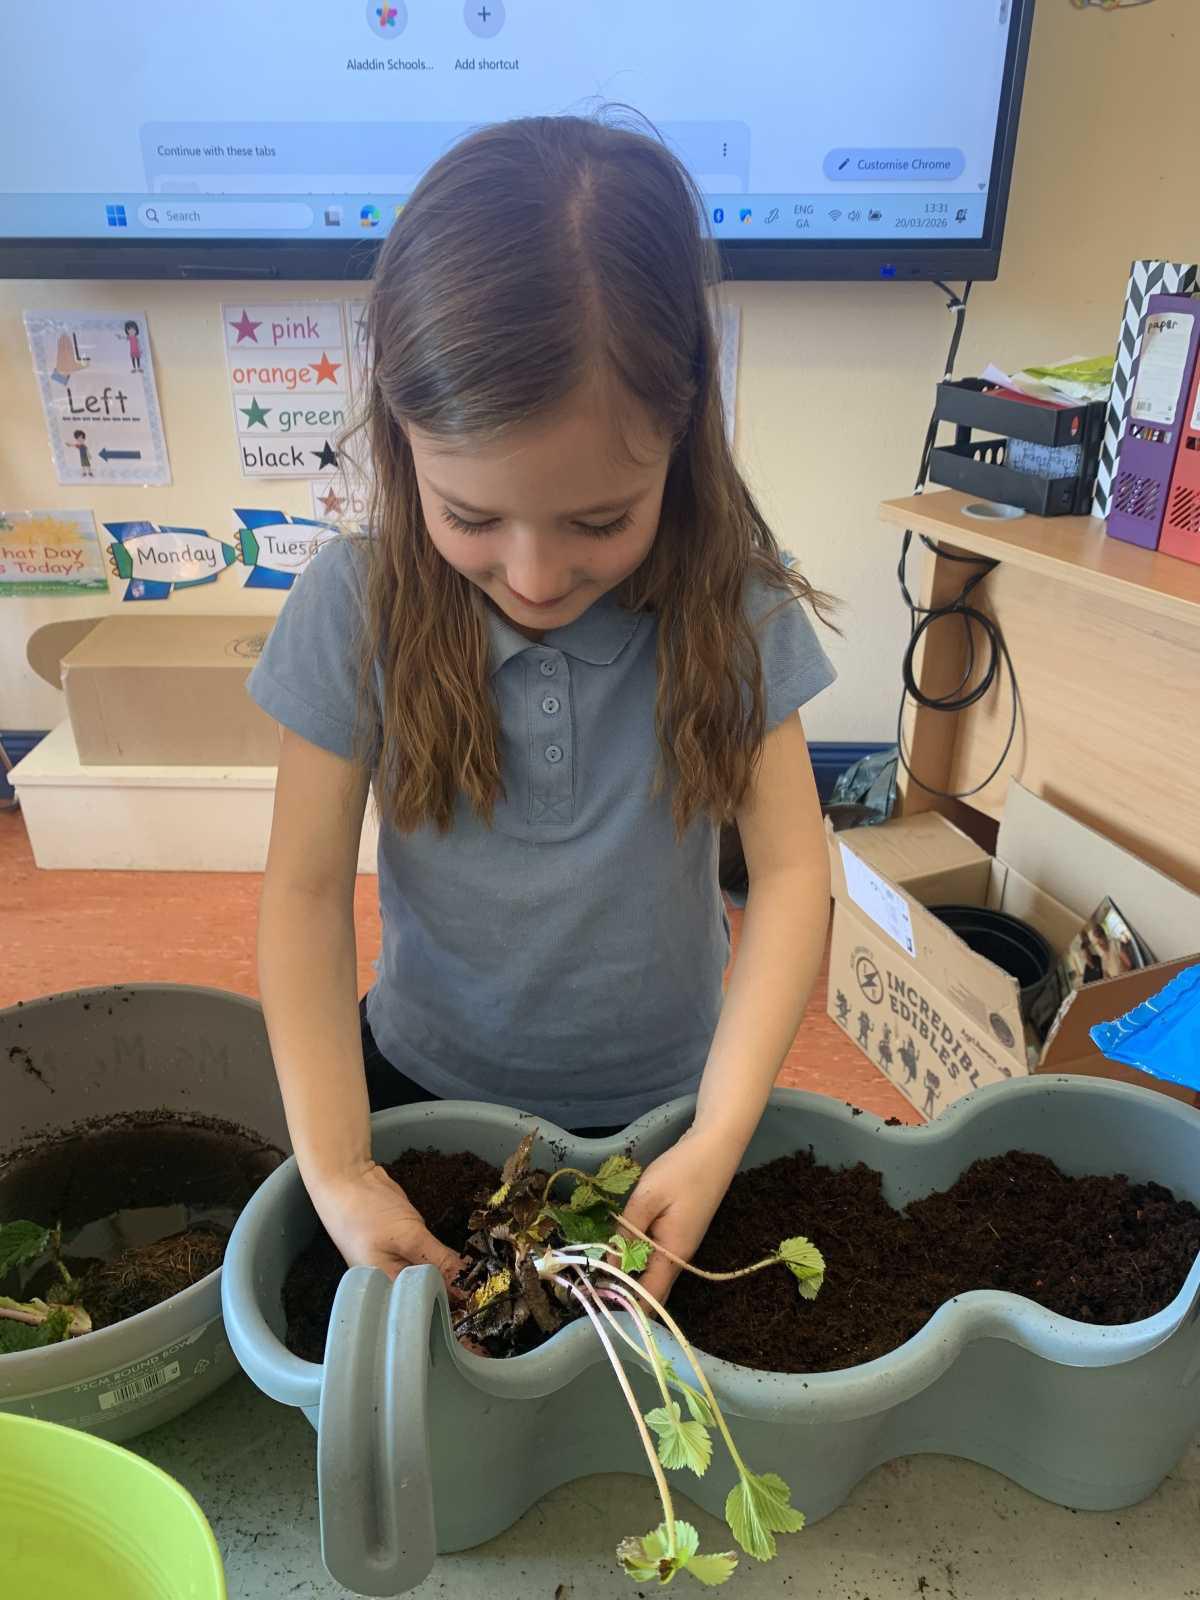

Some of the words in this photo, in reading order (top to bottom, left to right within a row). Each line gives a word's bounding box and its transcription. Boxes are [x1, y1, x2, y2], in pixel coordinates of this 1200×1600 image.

[347, 58, 385, 71] Aladdin
[454, 58, 476, 71] Add
[478, 58, 520, 71] shortcut
[157, 145, 201, 157] Continue
[203, 145, 225, 157] with
[226, 145, 253, 157] these
[255, 145, 276, 157] tabs
[857, 158, 909, 171] Customise
[911, 158, 951, 170] Chrome
[166, 209, 201, 223] Search
[793, 204, 814, 216] ENG
[795, 218, 810, 229] GA
[895, 216, 948, 229] 20/03/2026
[271, 316, 320, 346] pink
[1147, 319, 1178, 334] paper
[232, 366, 310, 390] orange
[67, 387, 128, 415] Left
[279, 408, 345, 434] green
[243, 446, 305, 468] black
[264, 535, 318, 556] Tuesd
[0, 547, 36, 559] hat
[44, 547, 83, 561] Day
[137, 547, 217, 568] Monday
[13, 560, 84, 576] Today?
[886, 970, 980, 1089] INCREDIBL
[889, 994, 960, 1080] EDIBLES
[114, 1356, 160, 1380] ROUND
